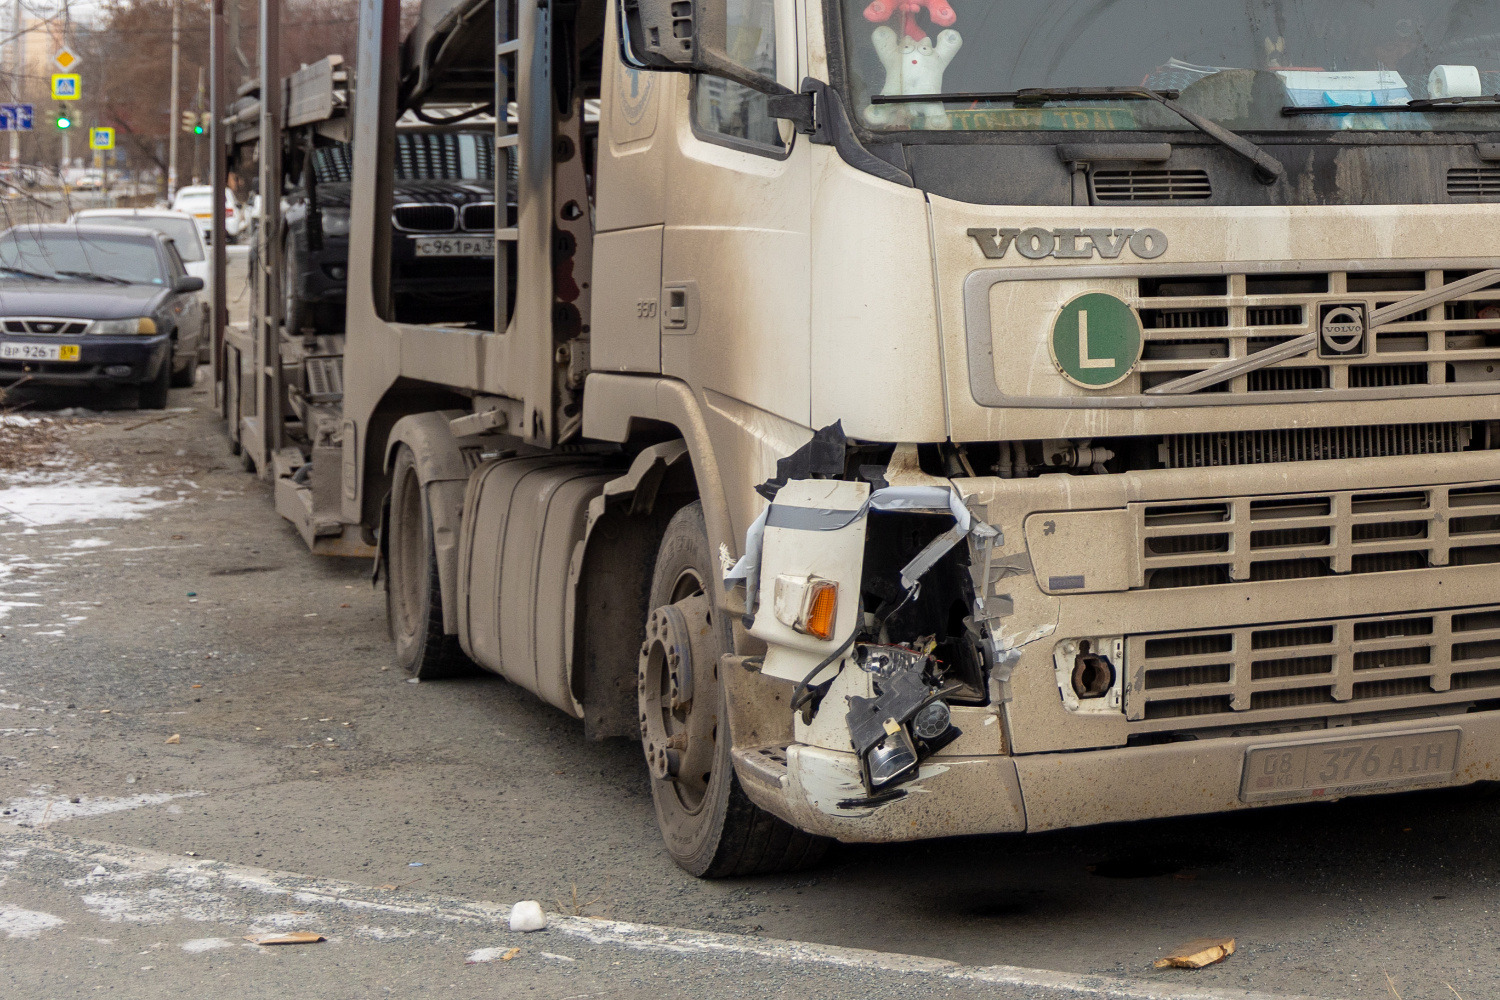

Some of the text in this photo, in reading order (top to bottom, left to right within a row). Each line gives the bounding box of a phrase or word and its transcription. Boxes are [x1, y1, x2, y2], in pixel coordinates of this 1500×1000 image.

[967, 227, 1168, 259] VOLVO
[1078, 309, 1116, 369] L
[1324, 325, 1362, 333] VOLVO
[22, 346, 47, 357] 926
[1263, 752, 1293, 776] 08
[1319, 745, 1382, 783] 376
[1387, 743, 1444, 776] AIH
[1276, 774, 1294, 787] KG
